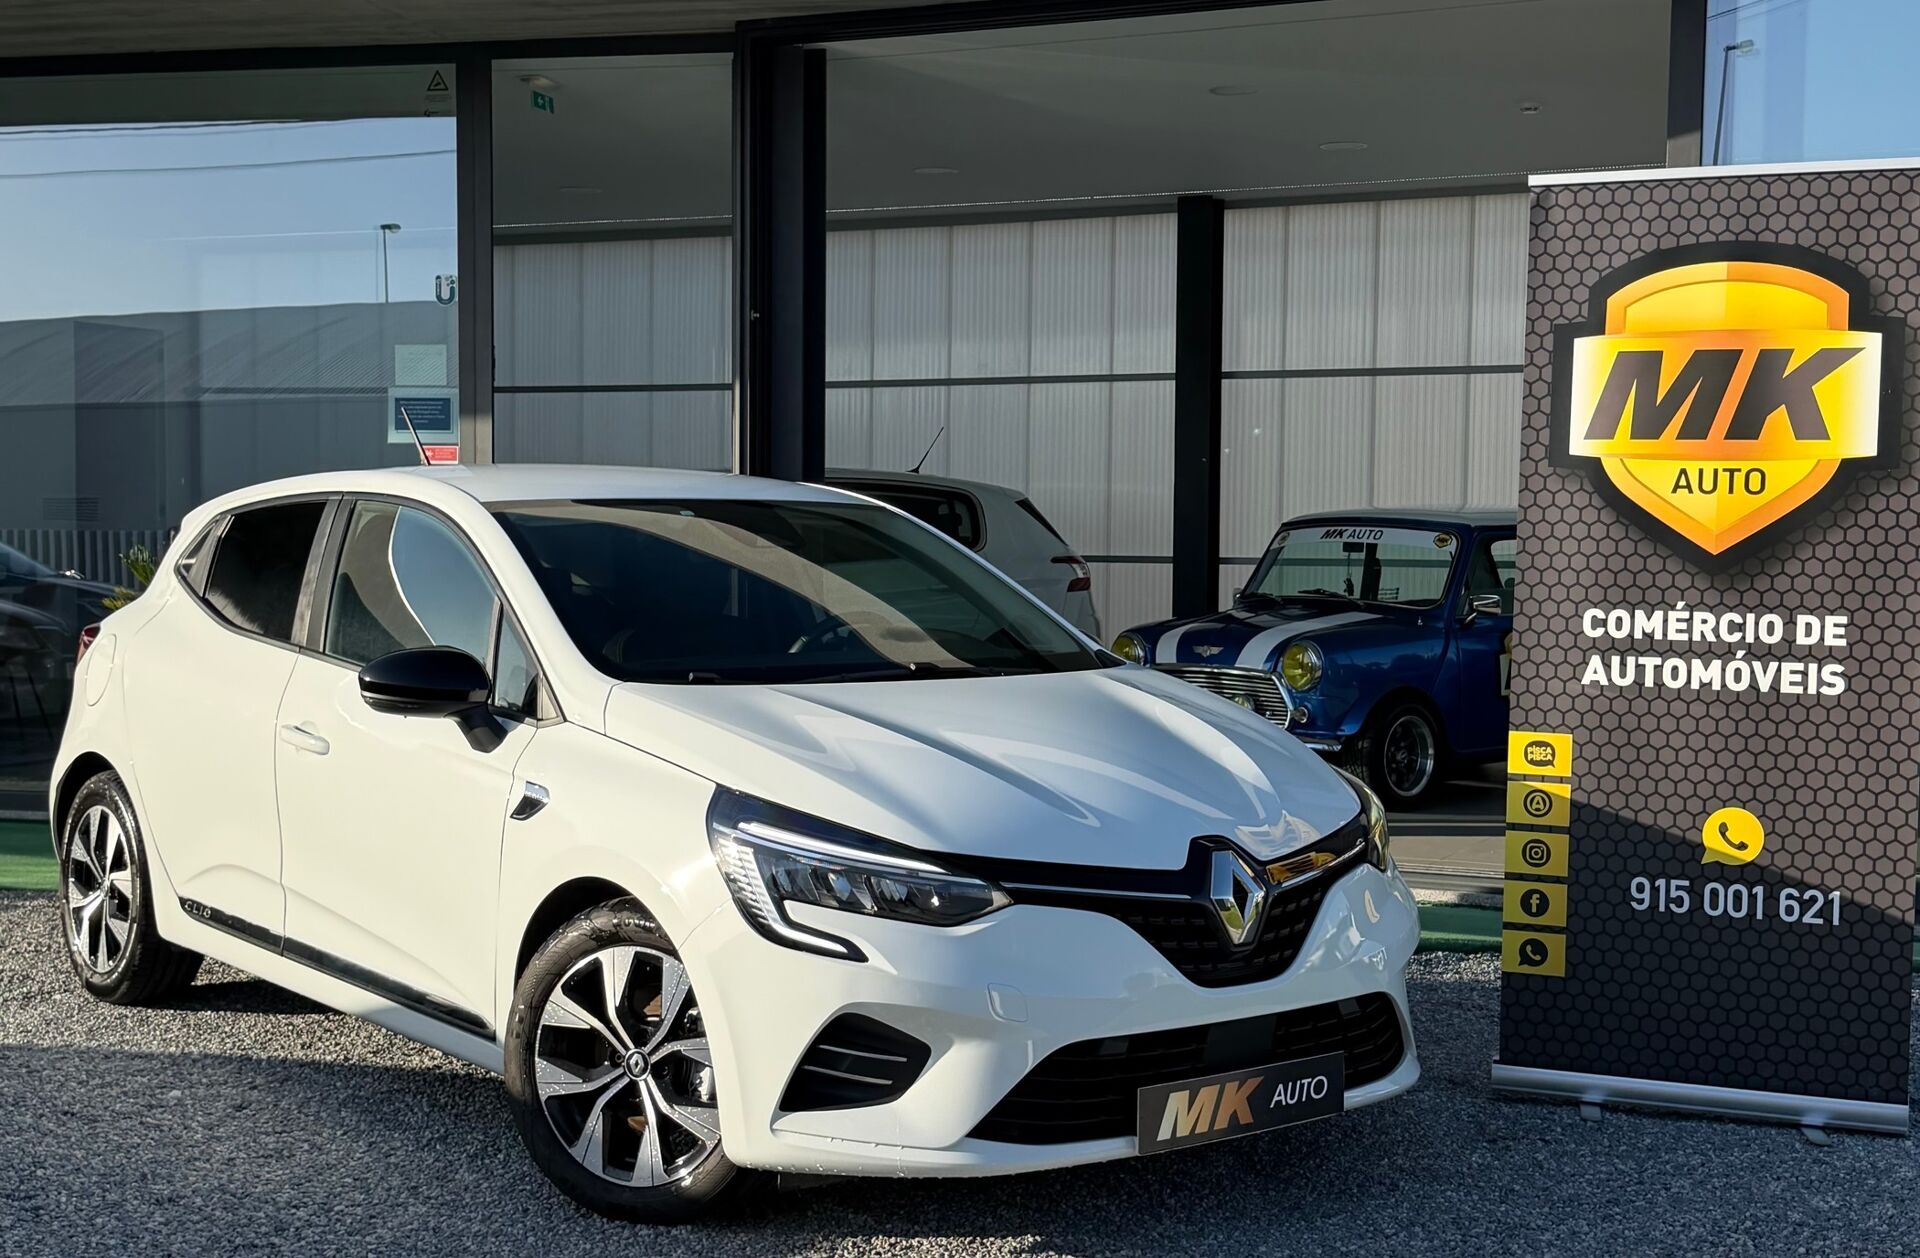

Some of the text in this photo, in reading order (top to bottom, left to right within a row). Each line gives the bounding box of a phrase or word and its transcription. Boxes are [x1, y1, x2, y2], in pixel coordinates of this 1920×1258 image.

[1584, 347, 1866, 441] MK
[1671, 467, 1767, 496] AUTO
[1320, 528, 1384, 541] MK AUTO
[1582, 601, 1848, 647] COMÉRCIO DE
[1581, 650, 1846, 696] AUTOMÓVEIS
[1527, 745, 1553, 754] PISCA
[1527, 753, 1553, 761] PISCA
[184, 900, 212, 919] CLIO
[1630, 876, 1841, 926] 915 001 621
[1156, 1075, 1328, 1142] MK AUTO
